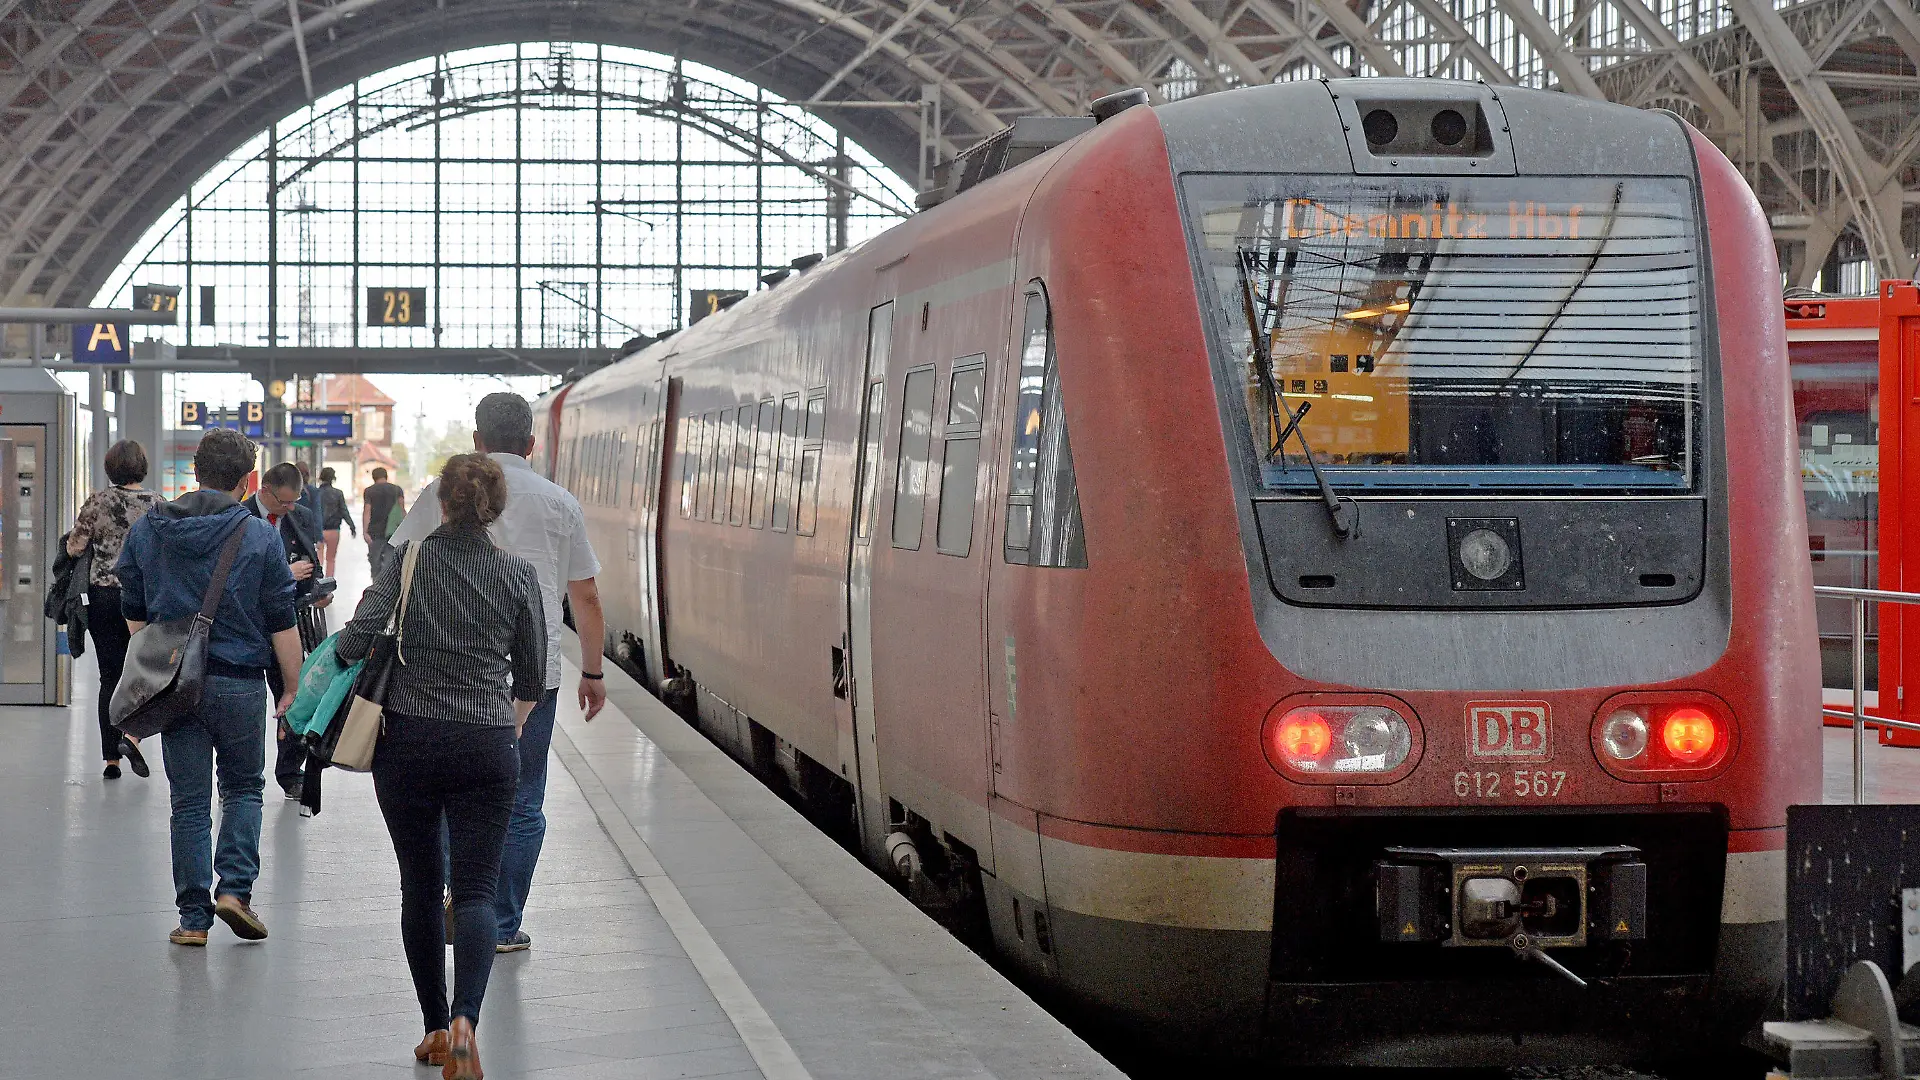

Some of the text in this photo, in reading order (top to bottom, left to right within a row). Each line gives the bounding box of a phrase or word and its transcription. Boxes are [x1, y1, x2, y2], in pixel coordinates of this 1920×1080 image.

[1286, 198, 1585, 239] Chemnitz Hbf
[383, 290, 411, 324] 23
[707, 293, 719, 315] 2
[87, 323, 122, 352] A
[183, 402, 199, 422] B
[247, 402, 264, 422] B
[1476, 711, 1542, 752] DB
[1454, 770, 1567, 798] 612 567
